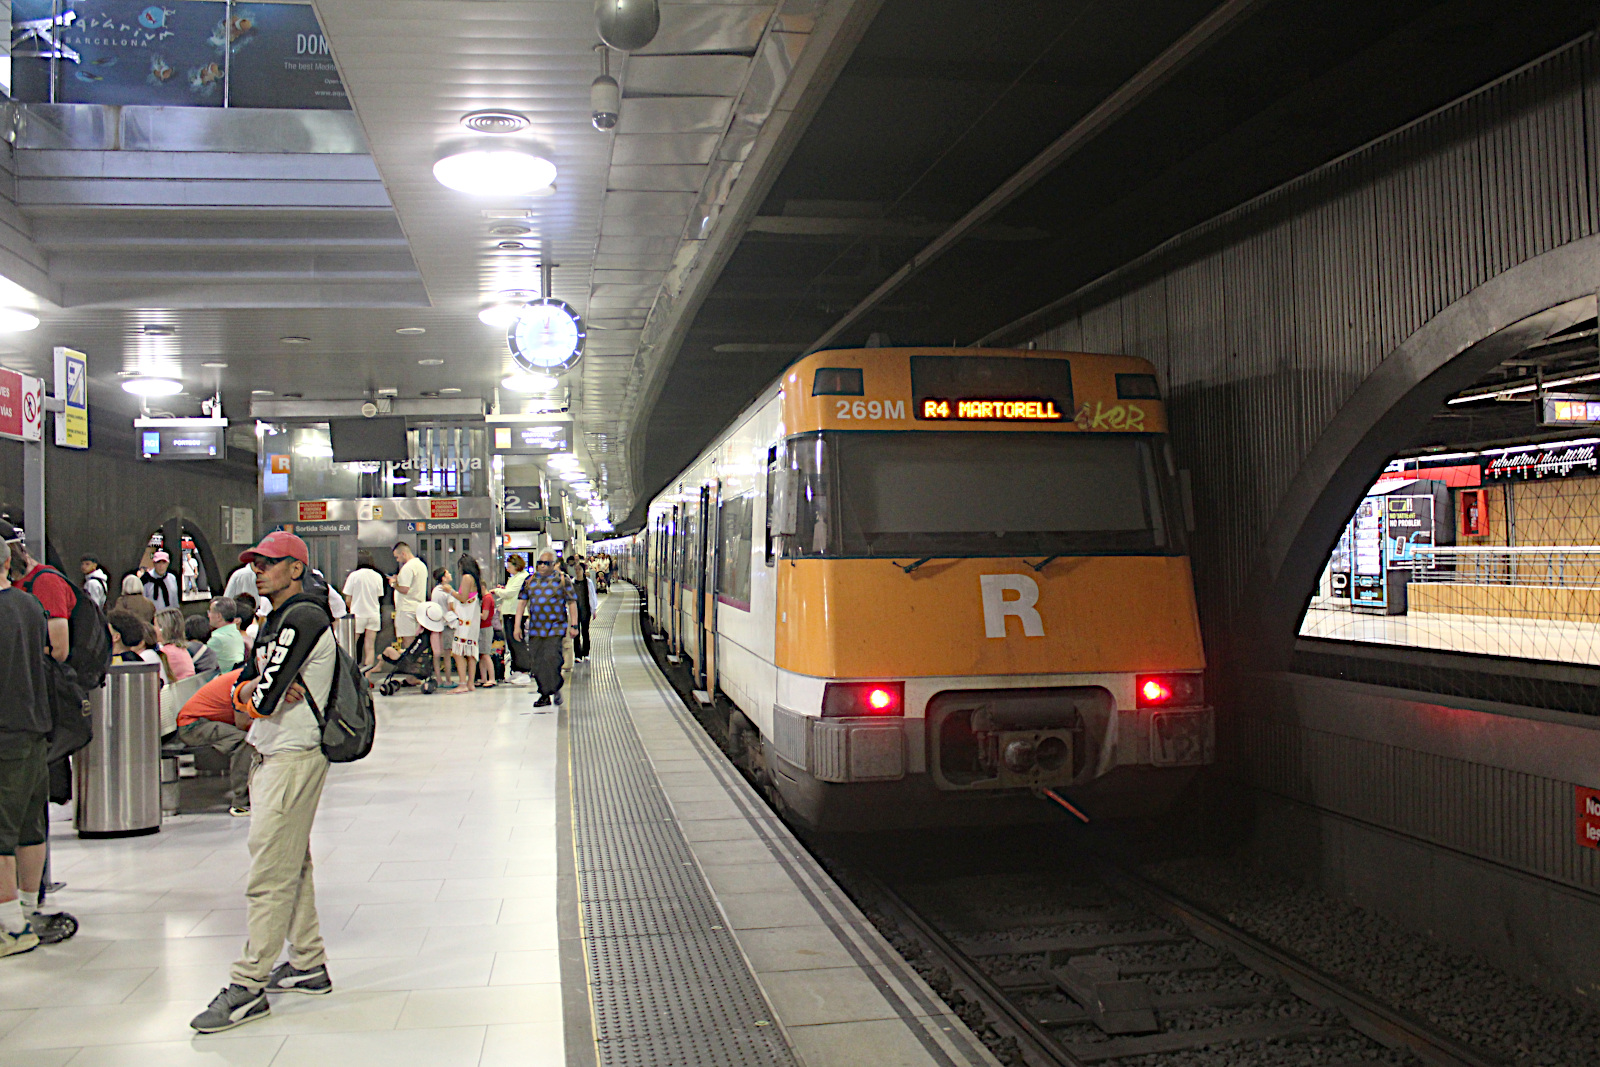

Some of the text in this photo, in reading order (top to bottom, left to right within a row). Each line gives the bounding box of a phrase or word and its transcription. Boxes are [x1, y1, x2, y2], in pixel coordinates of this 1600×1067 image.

[66, 37, 148, 47] BARCELONA
[284, 62, 297, 70] The
[299, 63, 313, 71] best
[836, 400, 905, 419] 269M
[925, 401, 1061, 418] R4 MARTORELL
[279, 457, 290, 470] R
[506, 496, 521, 509] 2
[980, 574, 1045, 638] R
